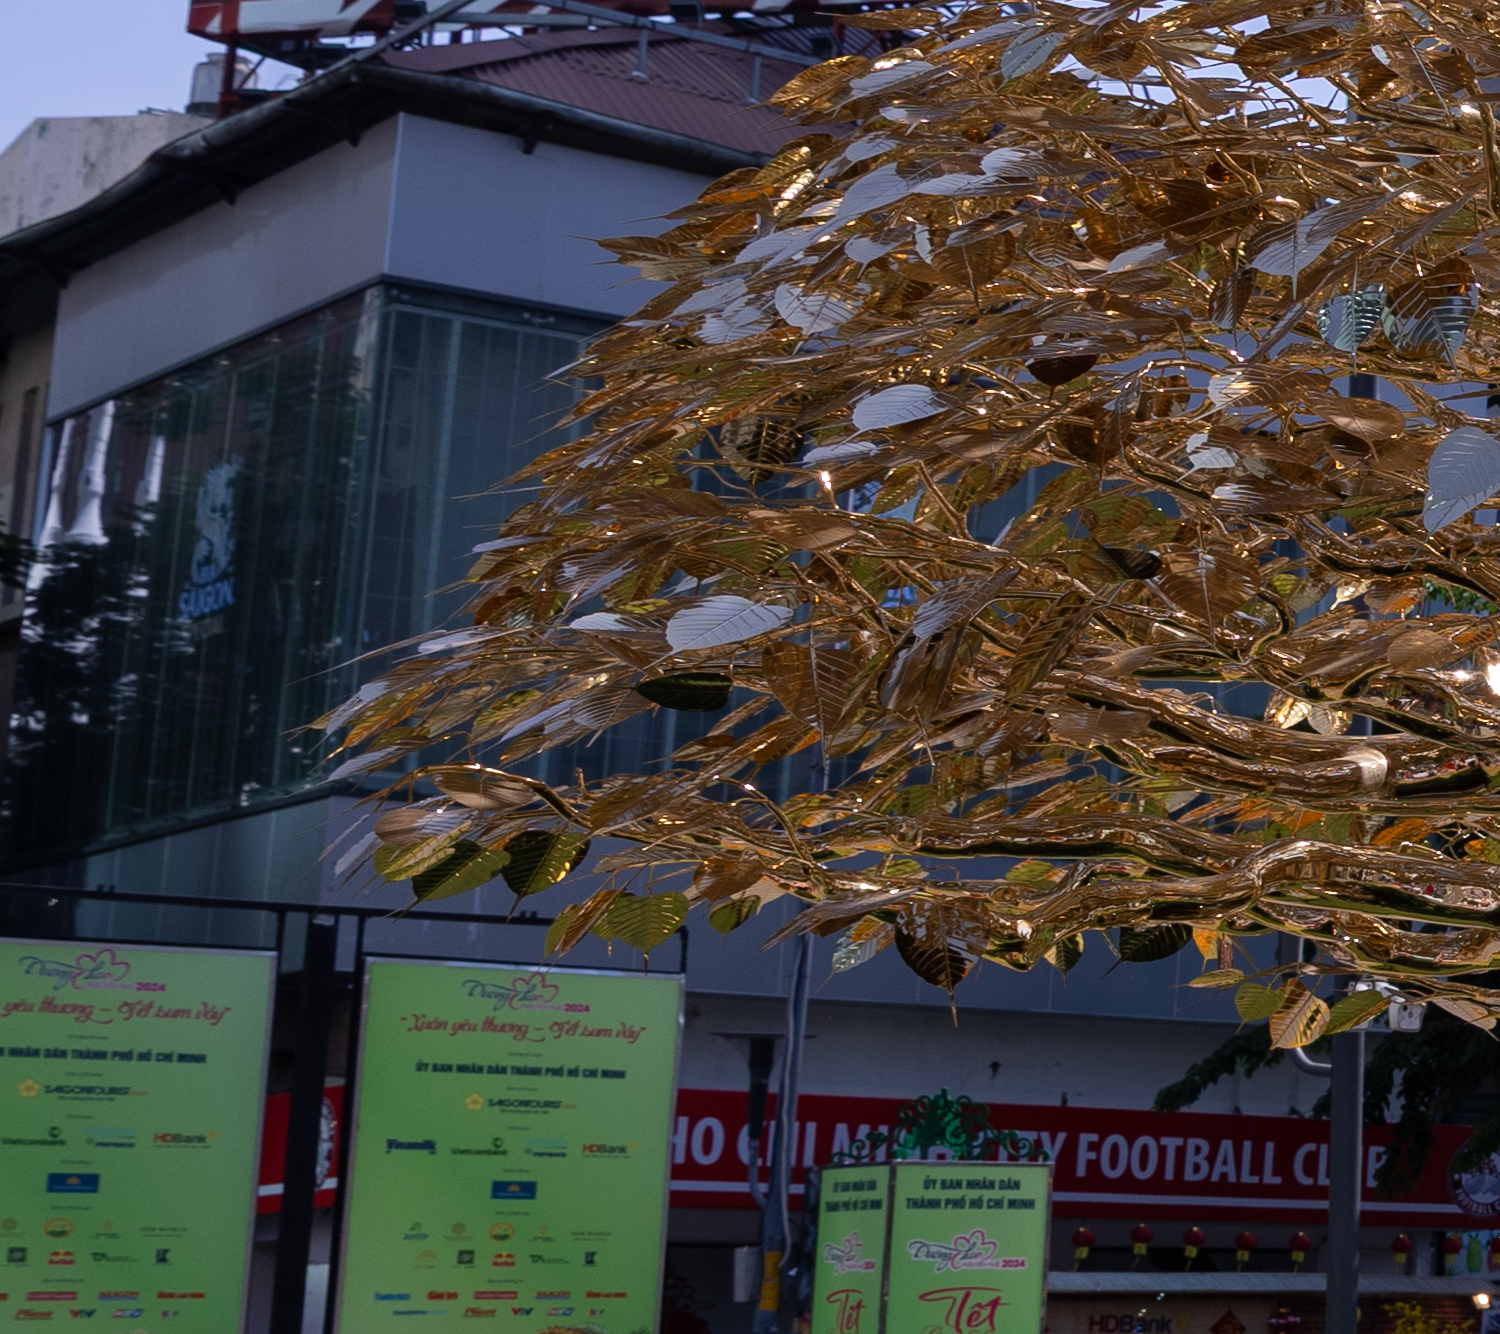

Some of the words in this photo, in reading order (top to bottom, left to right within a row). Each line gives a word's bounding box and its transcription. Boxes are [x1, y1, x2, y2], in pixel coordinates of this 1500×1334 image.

[582, 1143, 628, 1154] HDBank
[1075, 1133, 1282, 1185] FOOTBALL
[923, 1175, 937, 1191] ỦY
[939, 1178, 963, 1190] BAN
[965, 1175, 995, 1191] NHÂN
[998, 1175, 1021, 1191] DÂN
[905, 1194, 942, 1210] THÀNH
[944, 1194, 966, 1210] PHỐ
[968, 1194, 984, 1210] HỒ
[986, 1194, 1004, 1210] CHÍ
[1007, 1197, 1035, 1210] MINH
[1001, 1258, 1026, 1268] 2024
[918, 1286, 1012, 1334] Tết
[1088, 1314, 1172, 1334] HDBank
